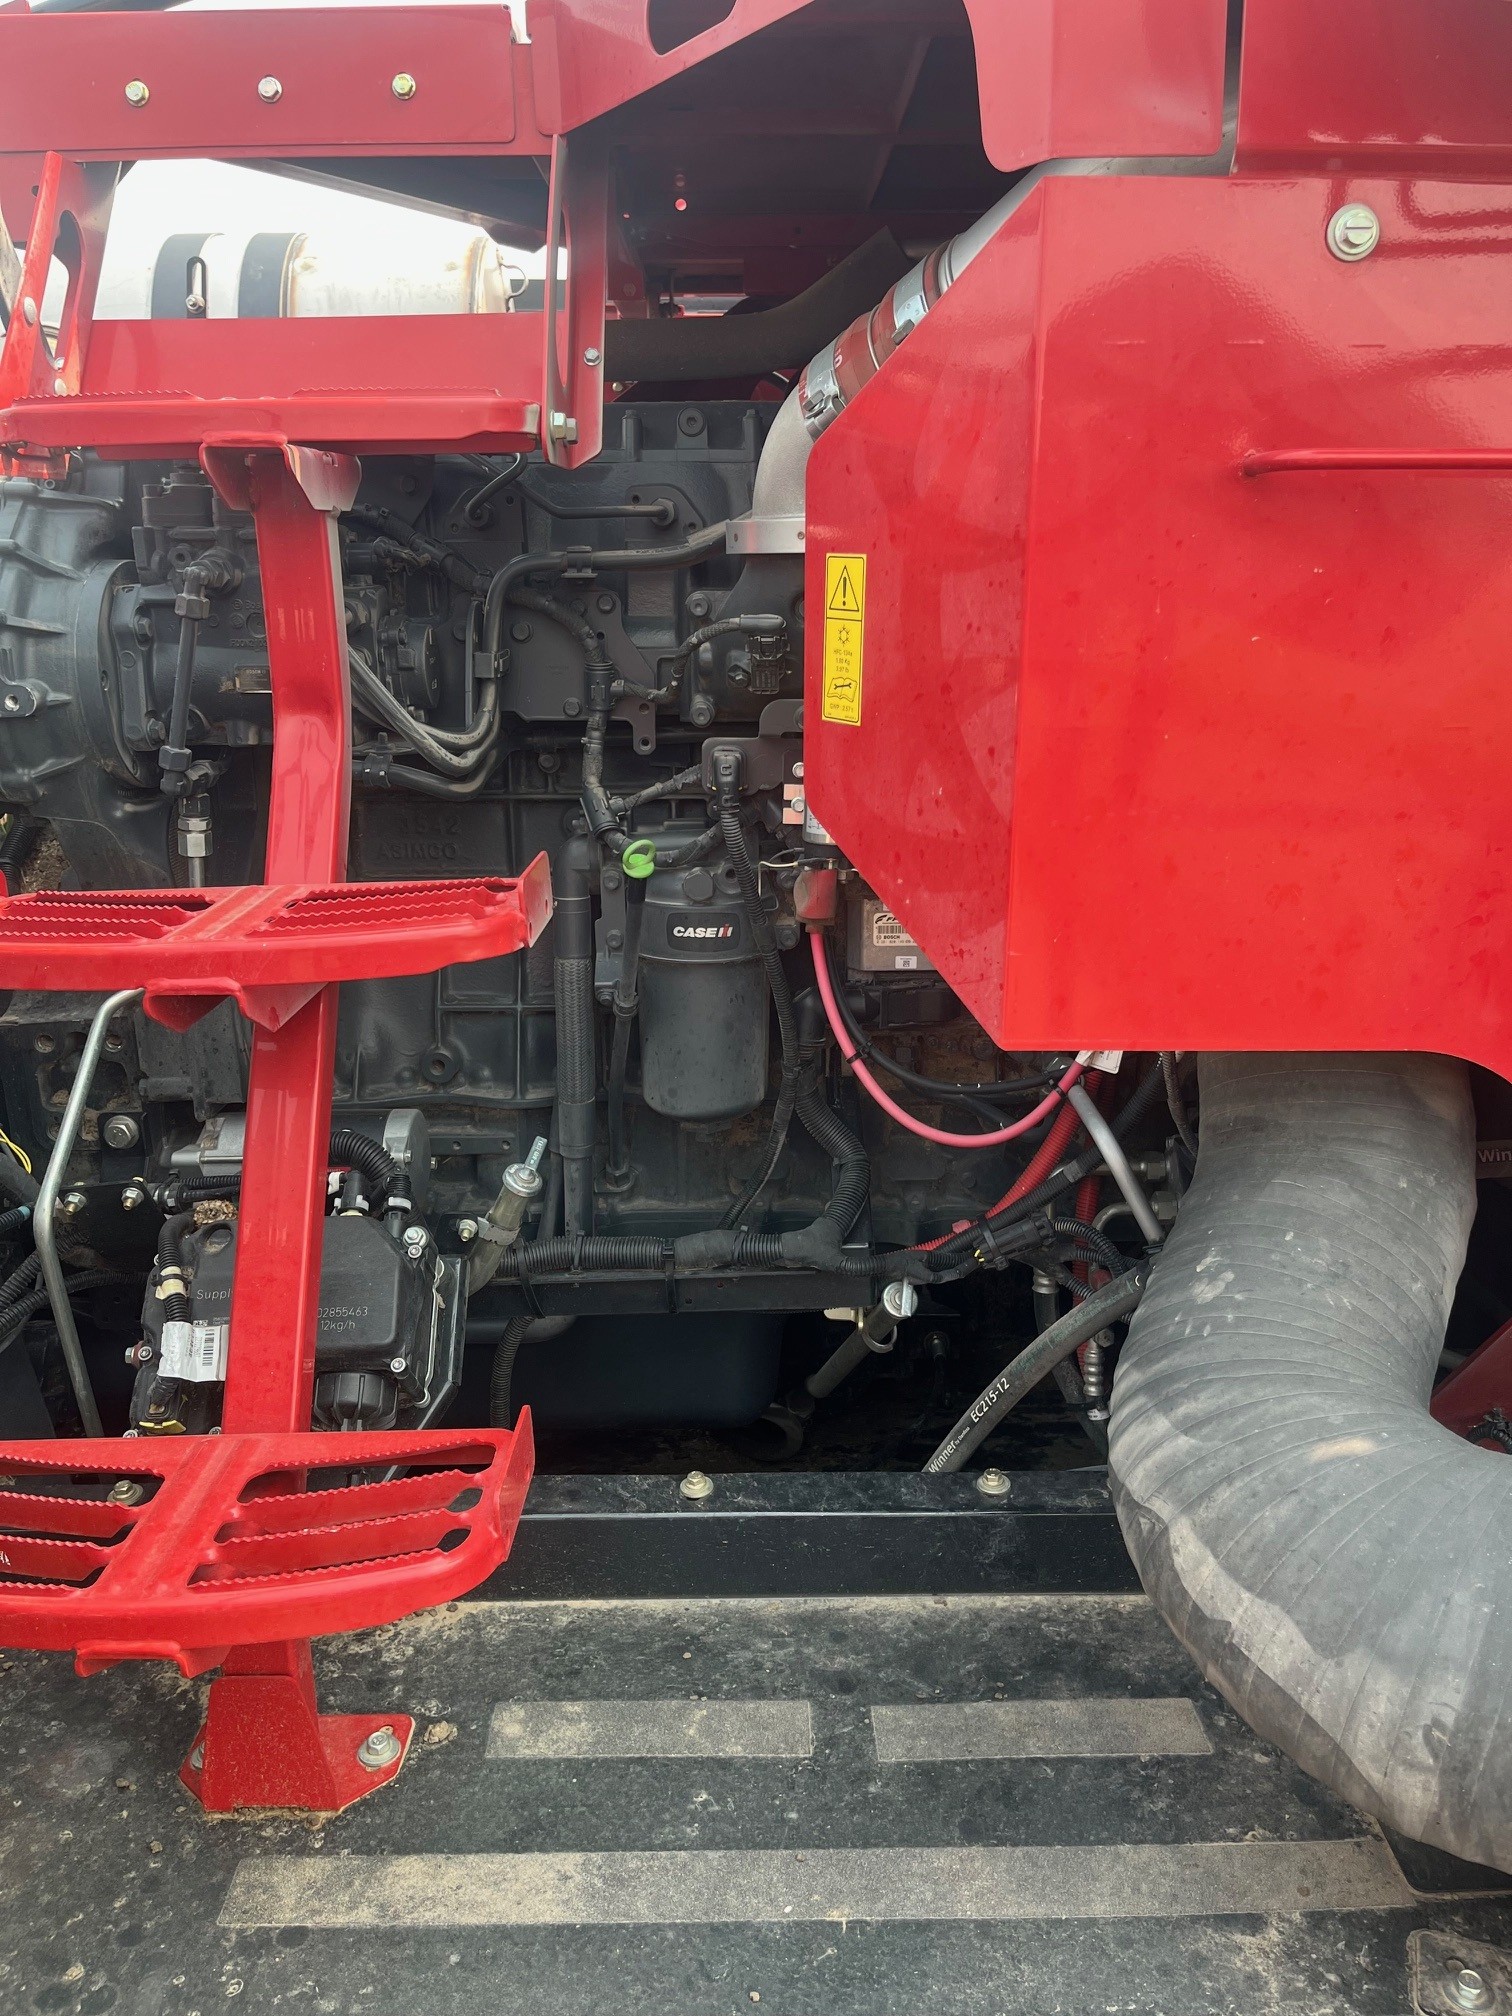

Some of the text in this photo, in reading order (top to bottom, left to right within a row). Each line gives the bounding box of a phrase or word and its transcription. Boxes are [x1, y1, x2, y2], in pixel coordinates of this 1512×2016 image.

[673, 926, 718, 938] CASE
[196, 1287, 233, 1301] Suppl
[320, 1320, 356, 1333] 12kg/h
[928, 1440, 957, 1473] Winner
[970, 1377, 1010, 1423] EC215-12
